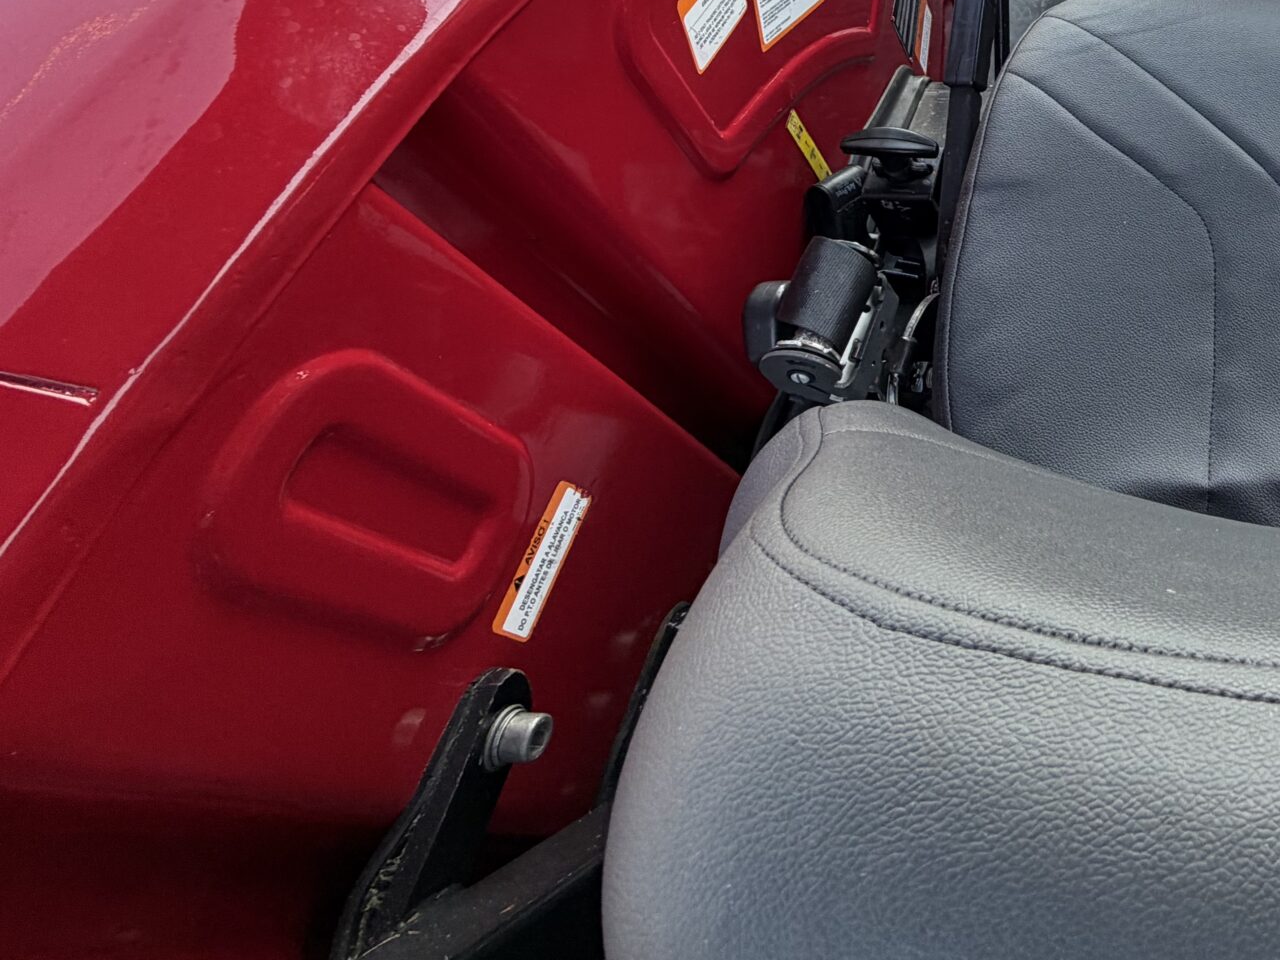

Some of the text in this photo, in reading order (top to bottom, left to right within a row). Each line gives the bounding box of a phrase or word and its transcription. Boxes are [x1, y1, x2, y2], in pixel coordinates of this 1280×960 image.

[518, 619, 527, 631] DO
[534, 571, 549, 597] ANTES
[547, 558, 555, 569] DE
[567, 498, 582, 525] MOTOR
[519, 557, 546, 611] DESENGATAR
[547, 511, 569, 551] ALAVANCA
[525, 527, 546, 565] AVISO
